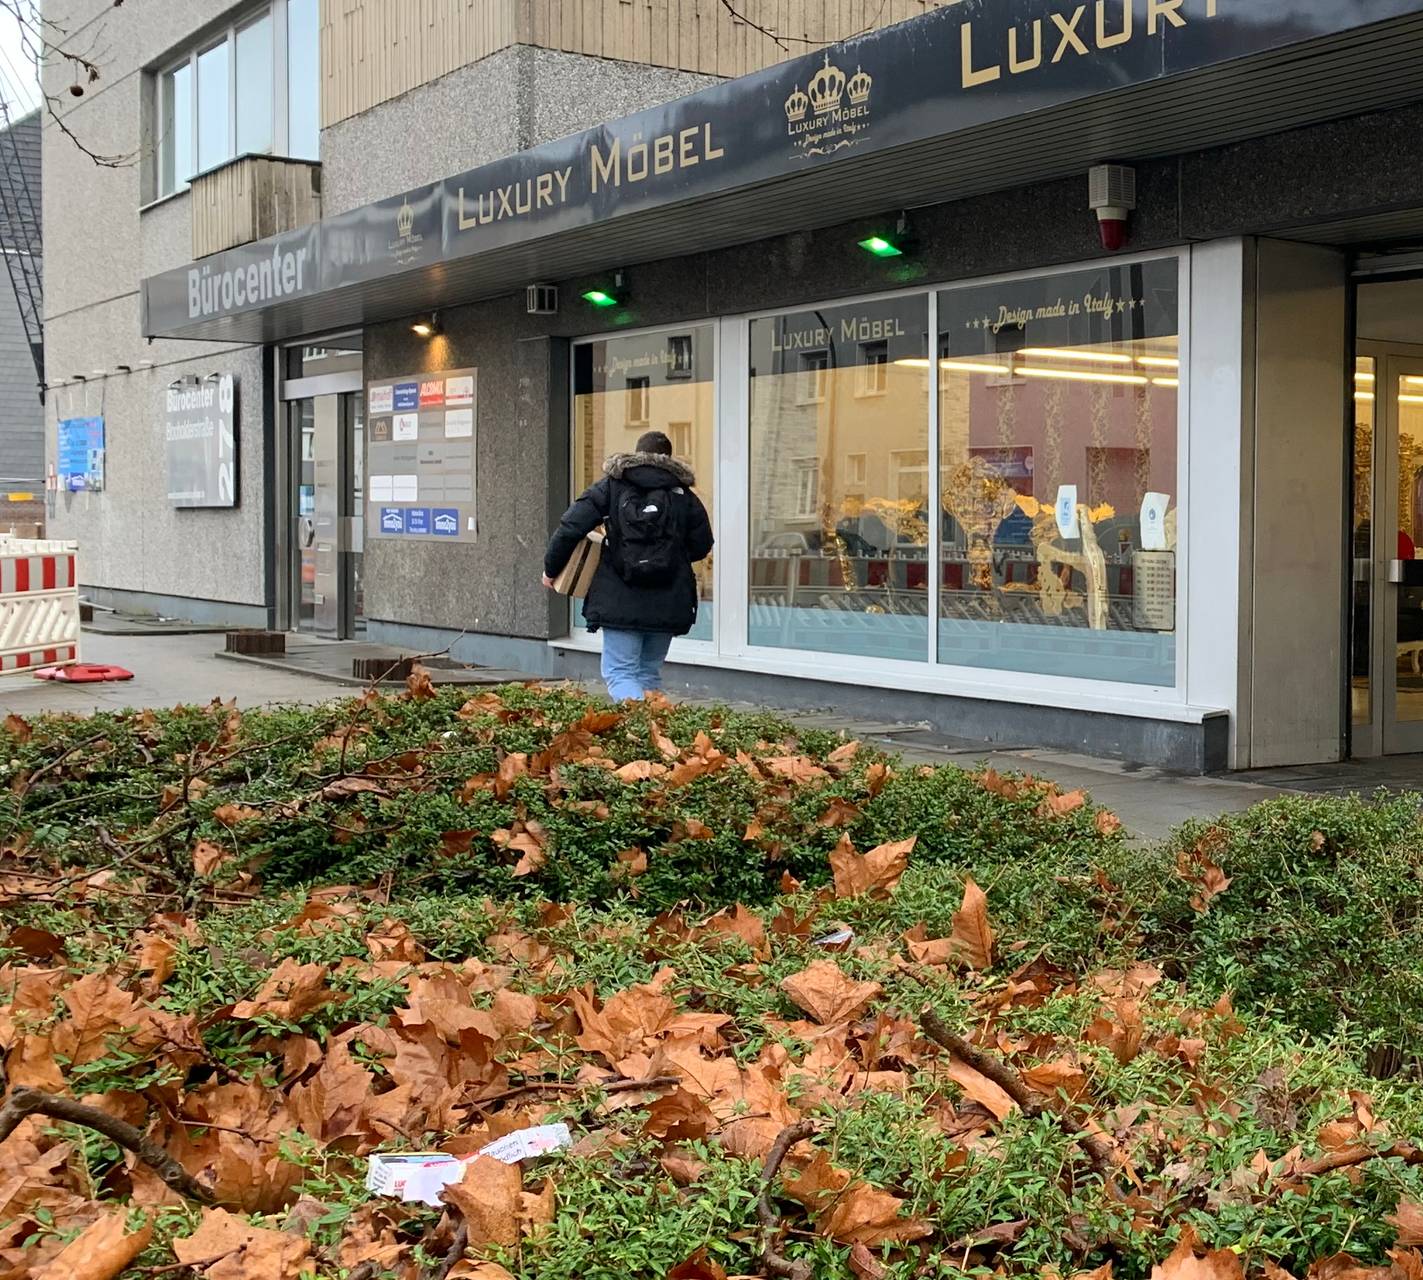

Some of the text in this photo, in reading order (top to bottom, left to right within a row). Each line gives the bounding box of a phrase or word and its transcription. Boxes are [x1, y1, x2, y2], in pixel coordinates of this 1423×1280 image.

[788, 105, 870, 135] LUXURY MÖBEL
[458, 122, 725, 230] LUXURY MÖBEL
[188, 243, 306, 318] Bürocenter
[992, 292, 1114, 334] Design made in Italy
[771, 316, 905, 352] LUXURY MÖBEL
[167, 385, 214, 412] Bürocenter
